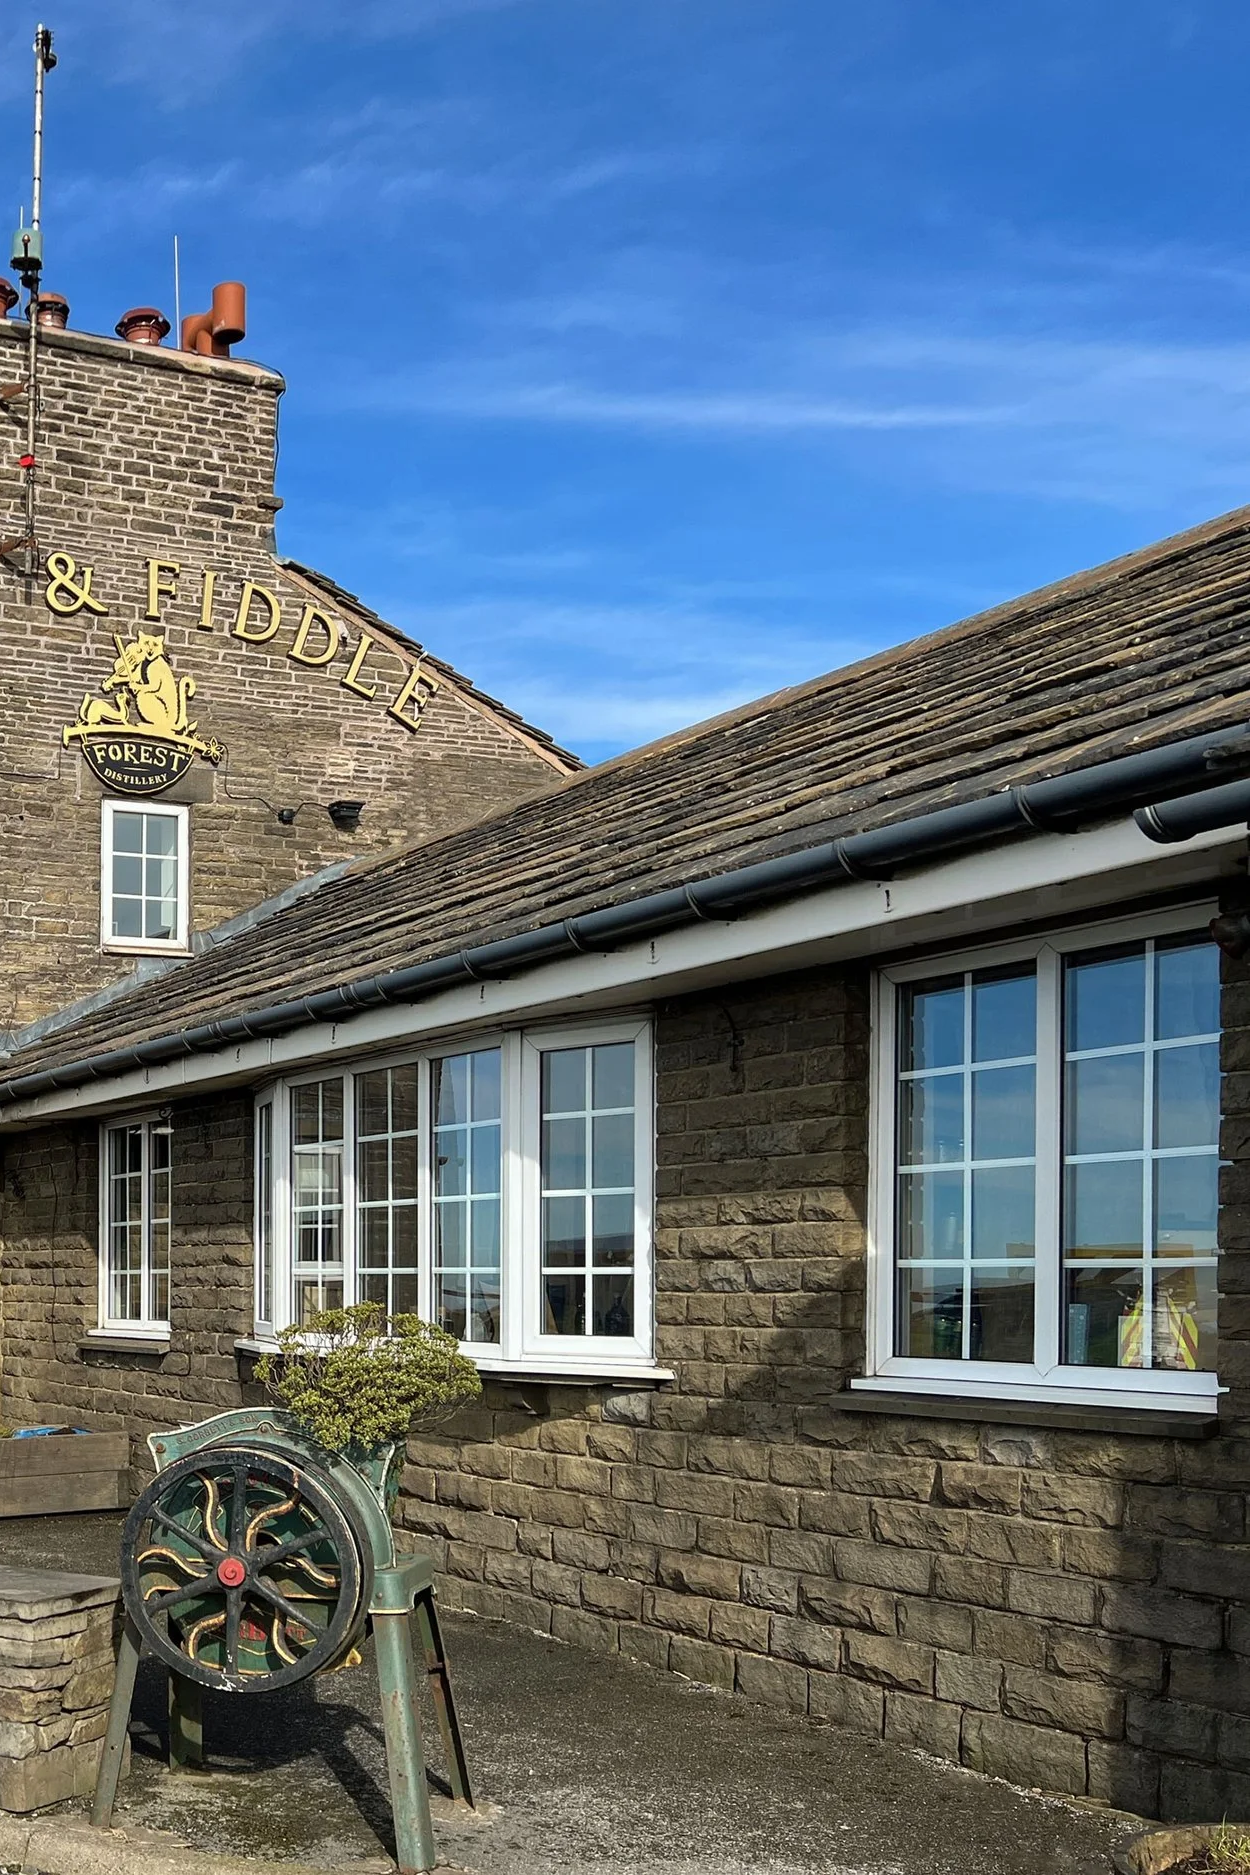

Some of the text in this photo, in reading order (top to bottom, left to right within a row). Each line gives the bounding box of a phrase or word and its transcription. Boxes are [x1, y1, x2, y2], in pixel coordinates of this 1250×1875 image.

[45, 551, 109, 616] &
[144, 557, 439, 732] FIDDLE
[92, 745, 185, 772] FOREST
[104, 768, 168, 785] DISTILLERY
